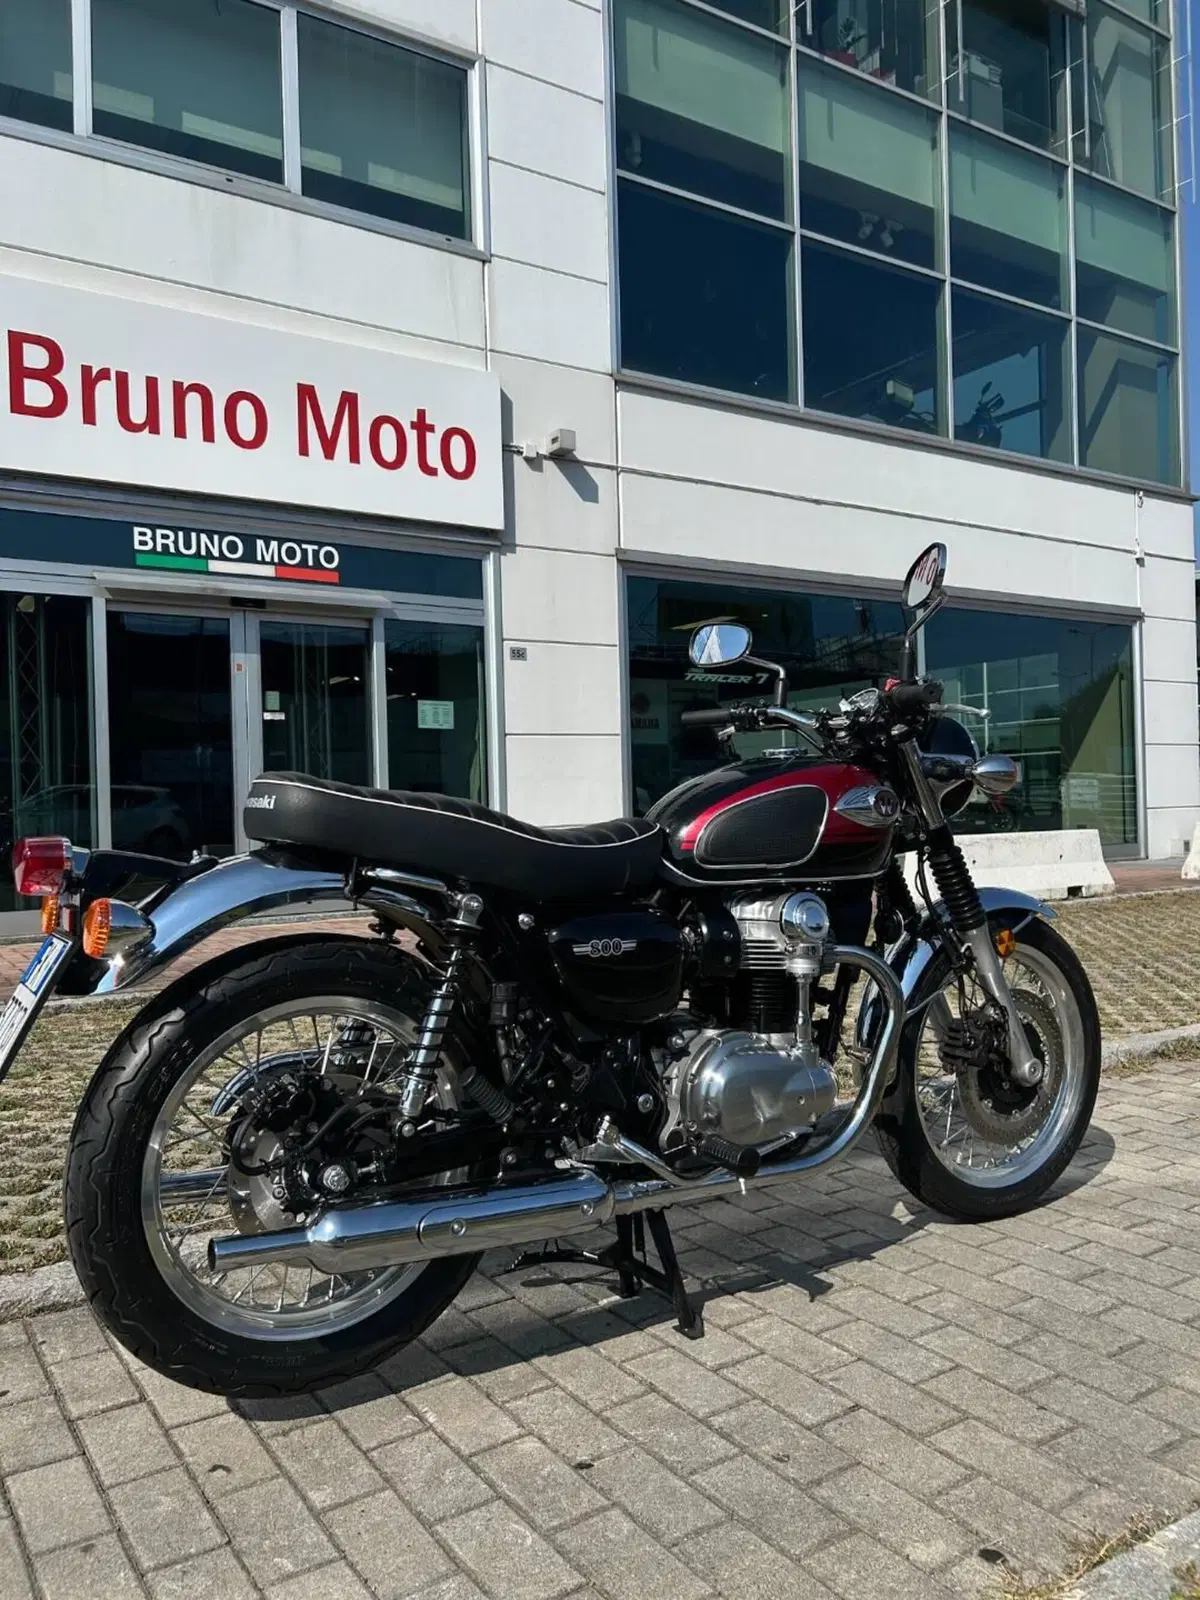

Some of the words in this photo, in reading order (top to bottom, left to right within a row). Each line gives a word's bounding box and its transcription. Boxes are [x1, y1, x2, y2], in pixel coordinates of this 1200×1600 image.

[7, 329, 268, 450] Bruno
[297, 382, 477, 480] Moto
[133, 526, 244, 559] BRUNO
[256, 538, 340, 569] MOTO
[684, 672, 753, 684] TRACER
[755, 672, 769, 684] 7
[589, 938, 623, 957] 800
